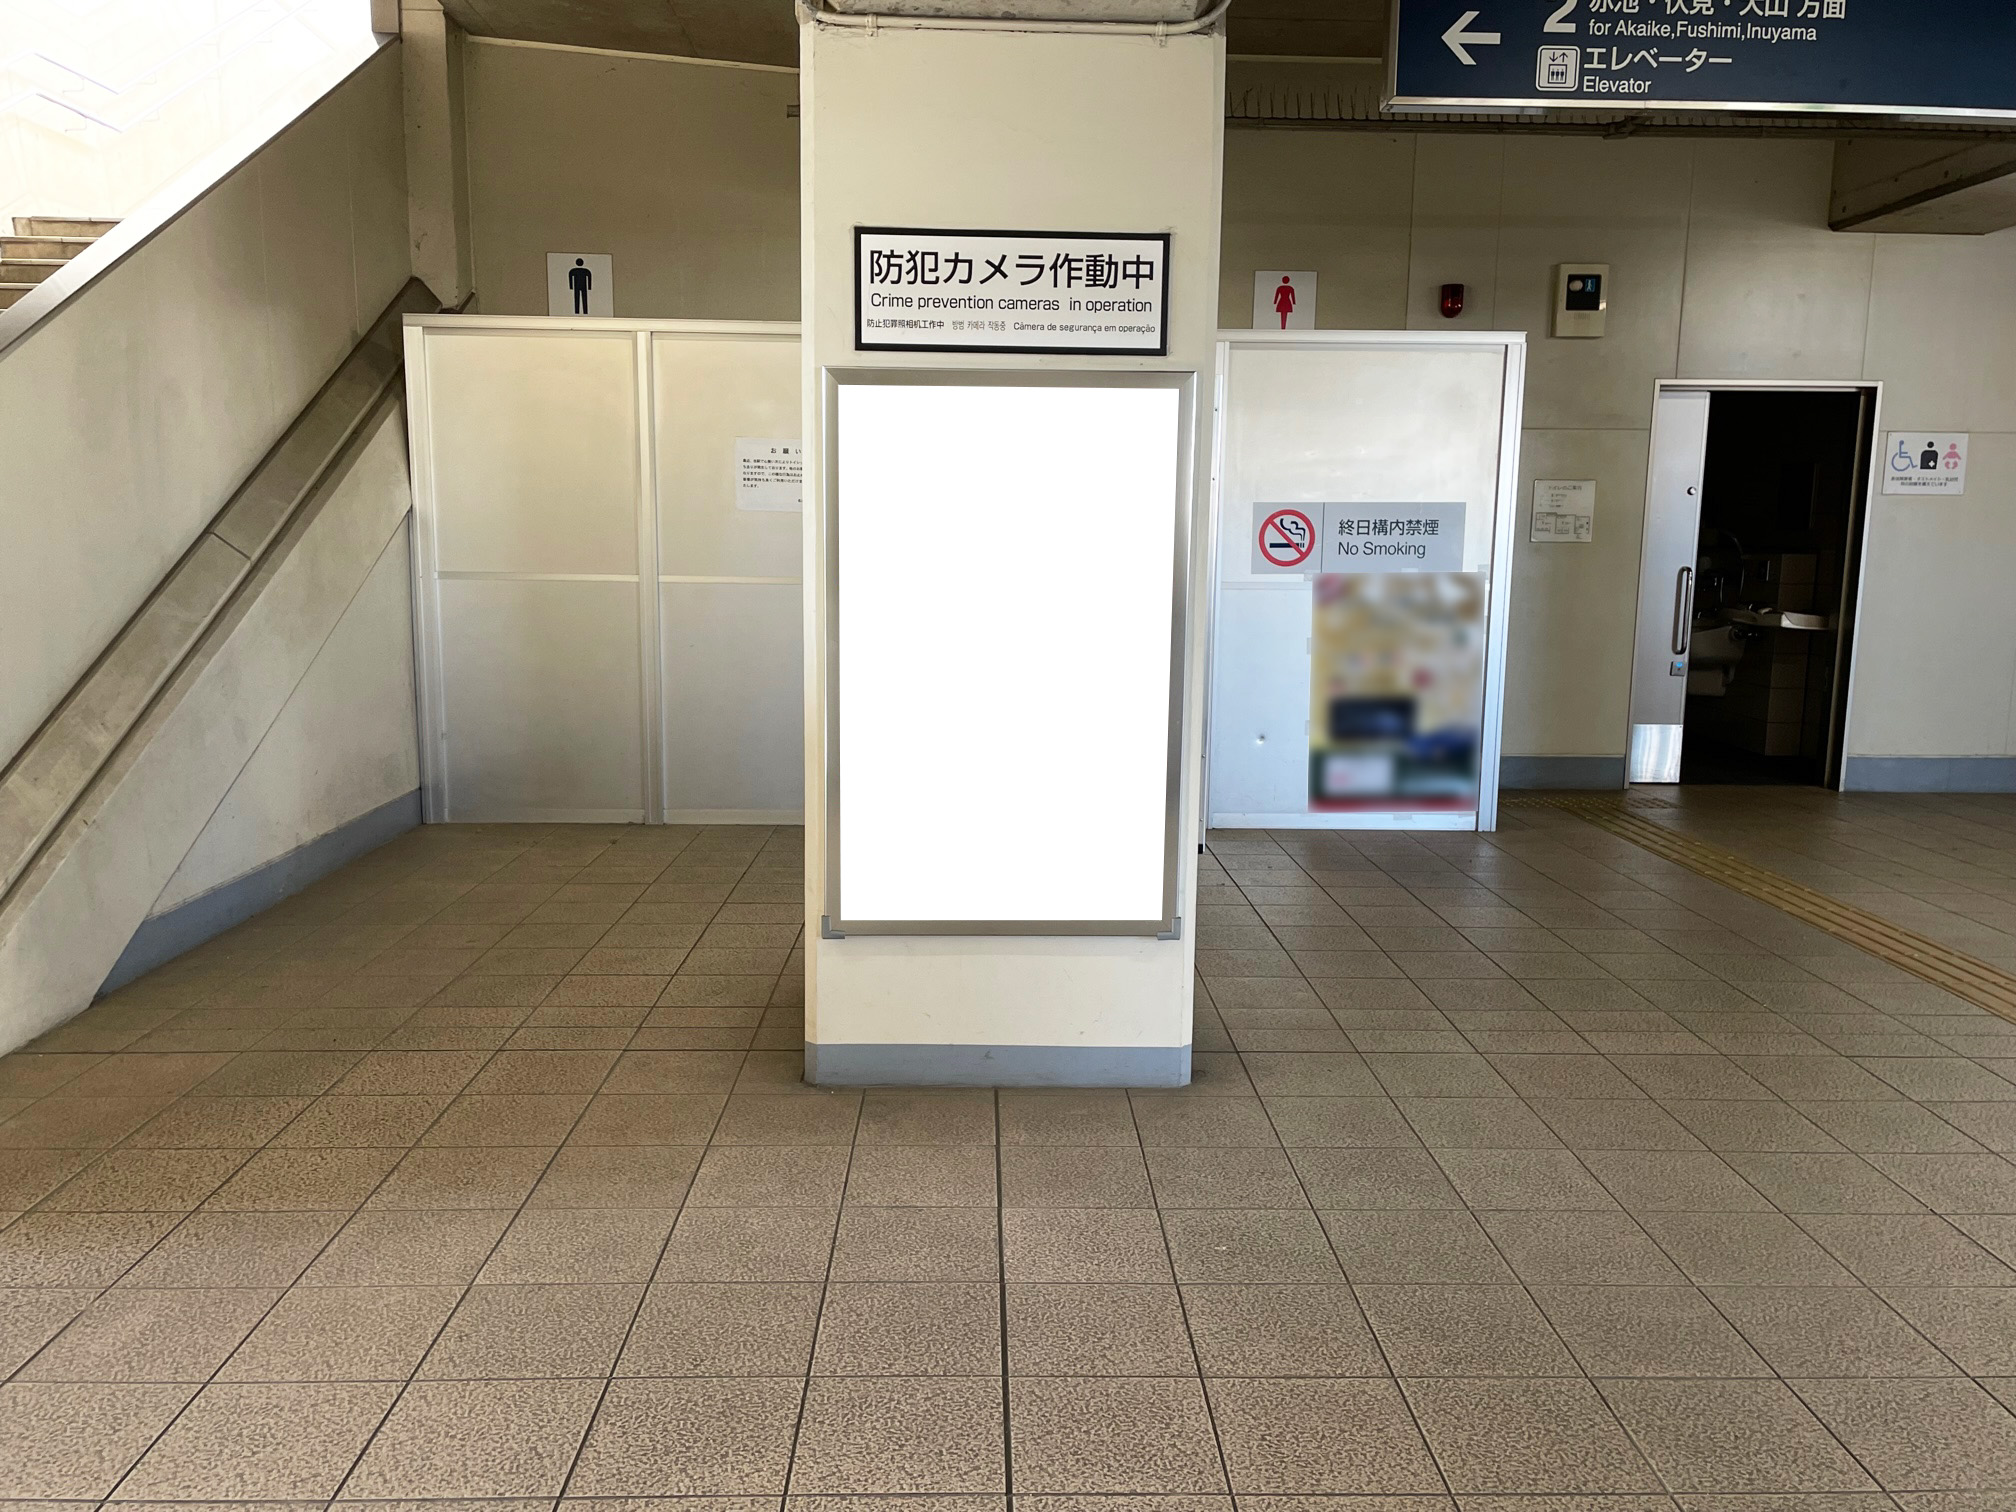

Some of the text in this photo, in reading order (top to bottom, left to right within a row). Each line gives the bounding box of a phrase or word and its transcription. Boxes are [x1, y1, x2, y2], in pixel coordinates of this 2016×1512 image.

[1543, 0, 1577, 33] 2
[1796, 0, 1846, 19] 方面
[1589, 19, 1817, 43] for Akaike,Fushimi,Inuyama
[1583, 46, 1733, 73] エレベーター
[1583, 76, 1652, 94] Elevator
[869, 249, 1154, 290] 防犯カメラ作動中
[871, 292, 1152, 314] Crime prevention cameras in operation
[1013, 321, 1045, 332] Câmera
[1046, 322, 1057, 331] de
[1059, 324, 1103, 334] segurança
[1118, 323, 1156, 335] operação
[1338, 518, 1440, 536] 終日構内禁煙
[1338, 541, 1426, 559] No Smoking
